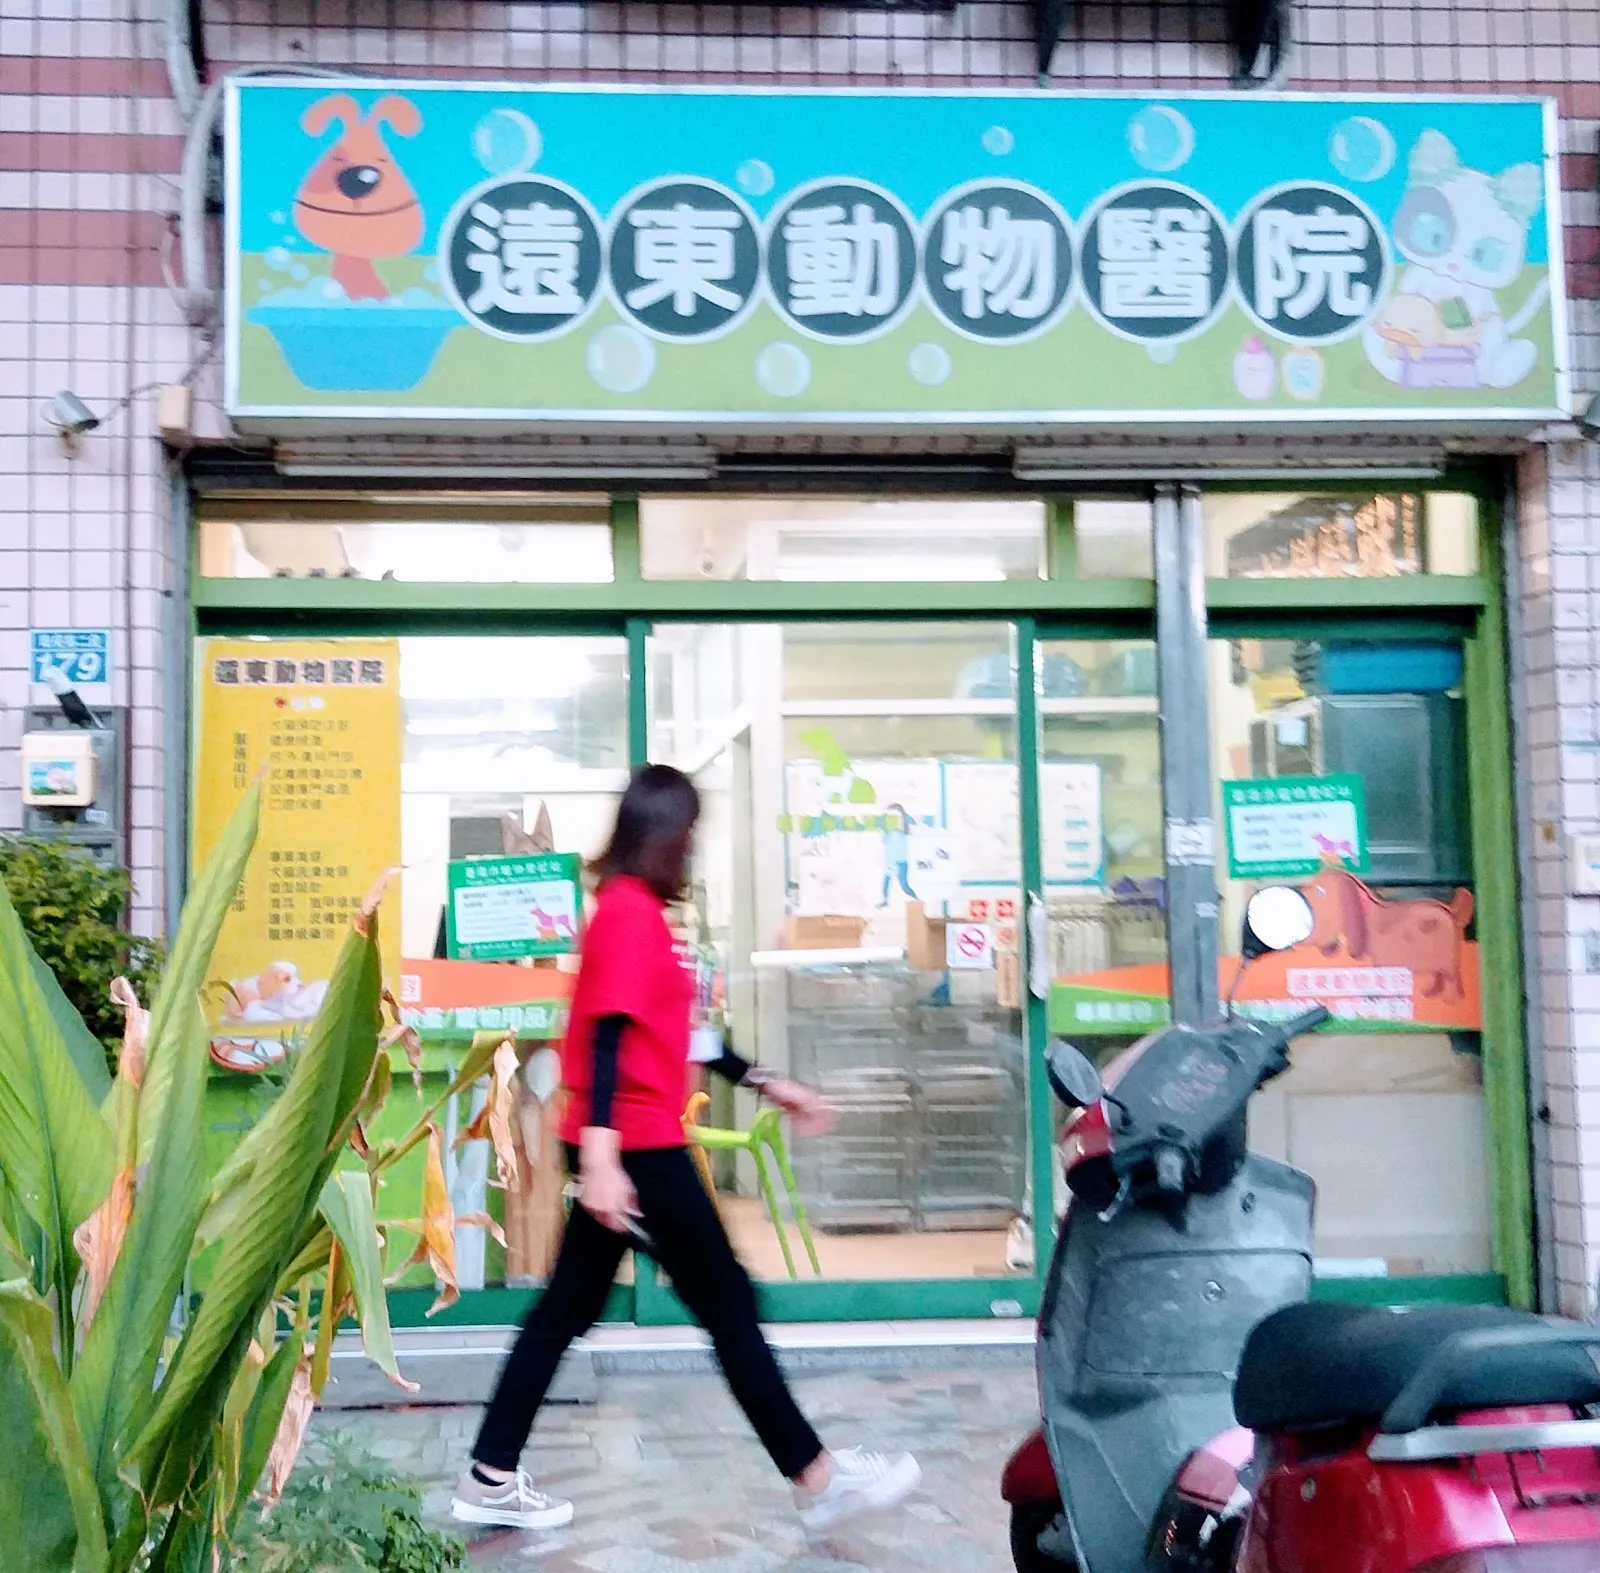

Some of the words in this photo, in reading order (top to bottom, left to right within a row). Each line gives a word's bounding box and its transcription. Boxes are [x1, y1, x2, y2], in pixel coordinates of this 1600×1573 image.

[466, 201, 1373, 320] 遠東動物醫院
[36, 652, 103, 681] 179
